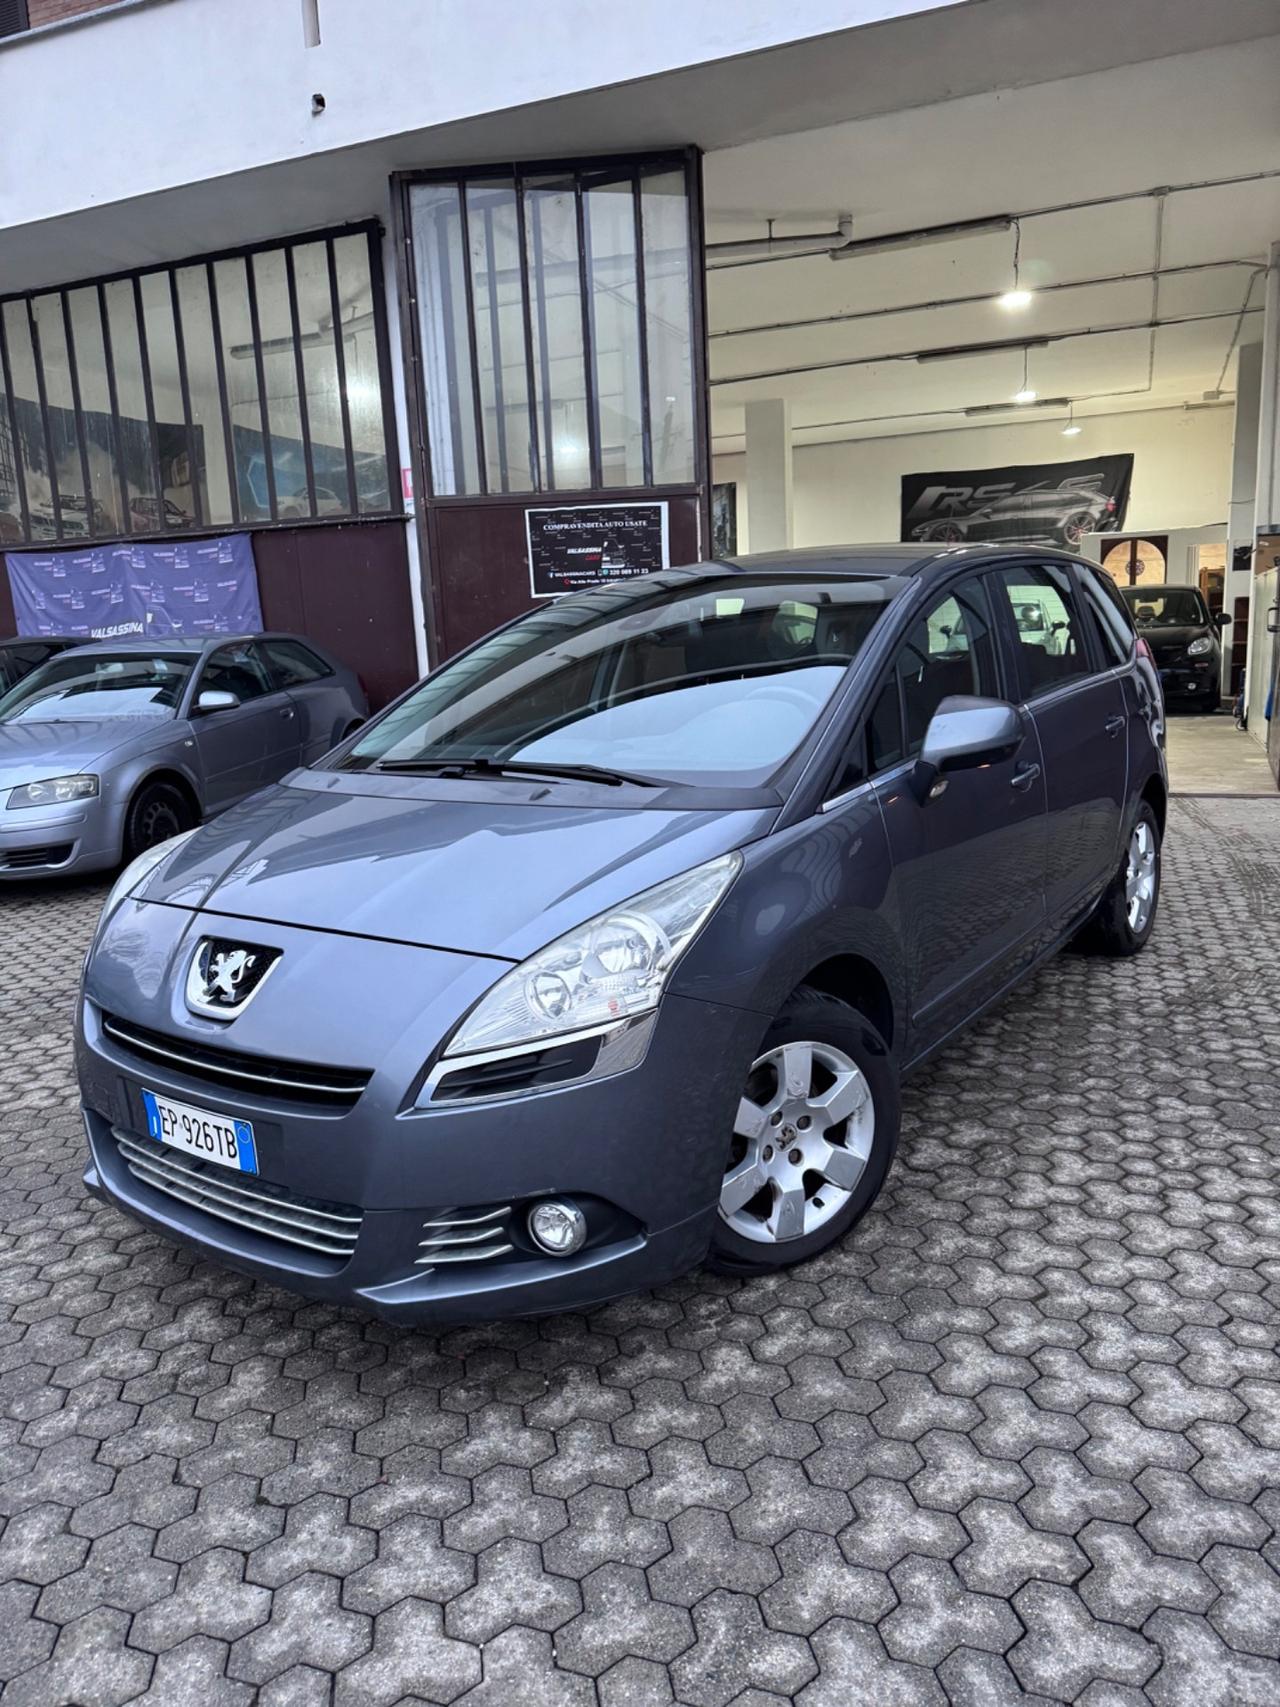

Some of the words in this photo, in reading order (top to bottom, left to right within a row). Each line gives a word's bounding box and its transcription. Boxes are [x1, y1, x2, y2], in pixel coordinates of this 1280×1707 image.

[543, 522, 603, 531] COMPRAVENDITA
[91, 622, 144, 638] VALSASSINA
[158, 1105, 178, 1137] EP
[182, 1114, 238, 1159] 926TB
